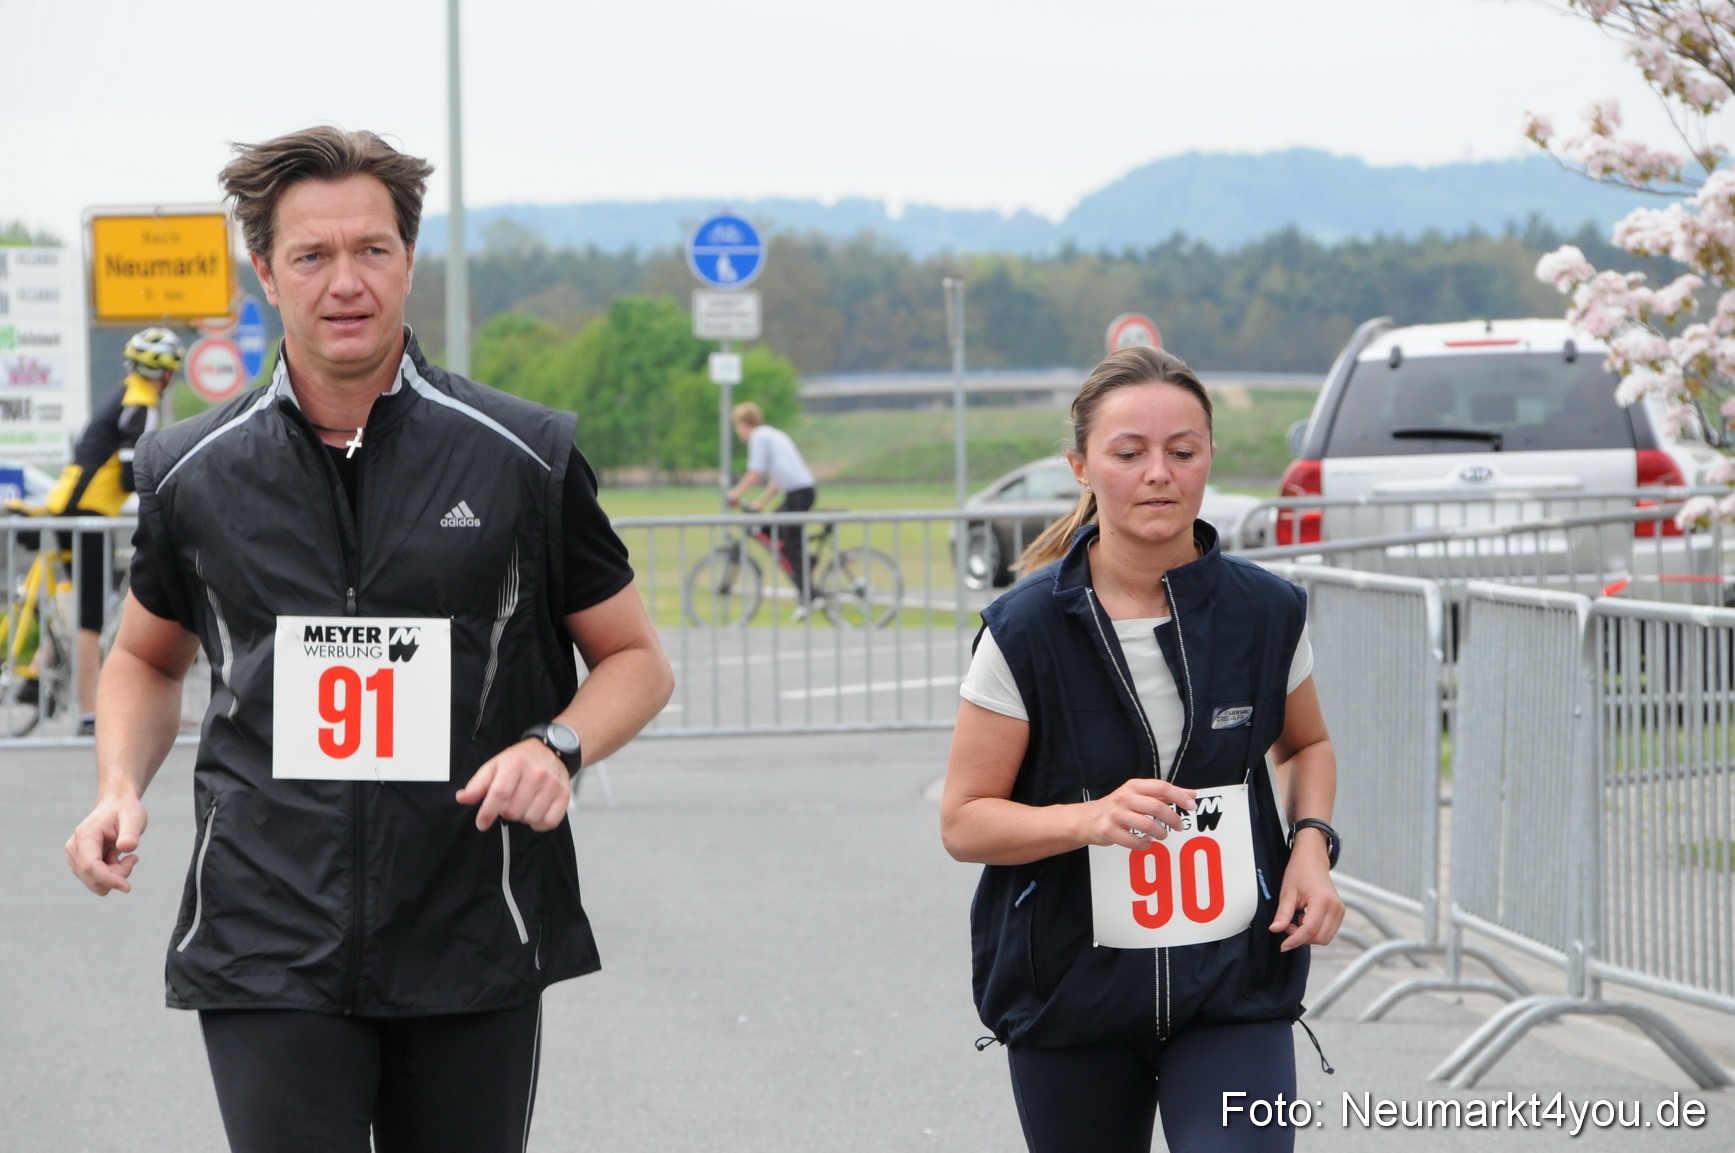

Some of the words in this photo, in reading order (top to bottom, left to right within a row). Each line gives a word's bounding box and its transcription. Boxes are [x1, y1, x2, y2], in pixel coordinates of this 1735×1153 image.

[105, 253, 218, 277] Neumarkt
[440, 516, 481, 528] adidas
[303, 625, 382, 644] MEYER
[303, 645, 383, 659] WERBUNG
[318, 665, 394, 759] 91
[1129, 836, 1225, 930] 90
